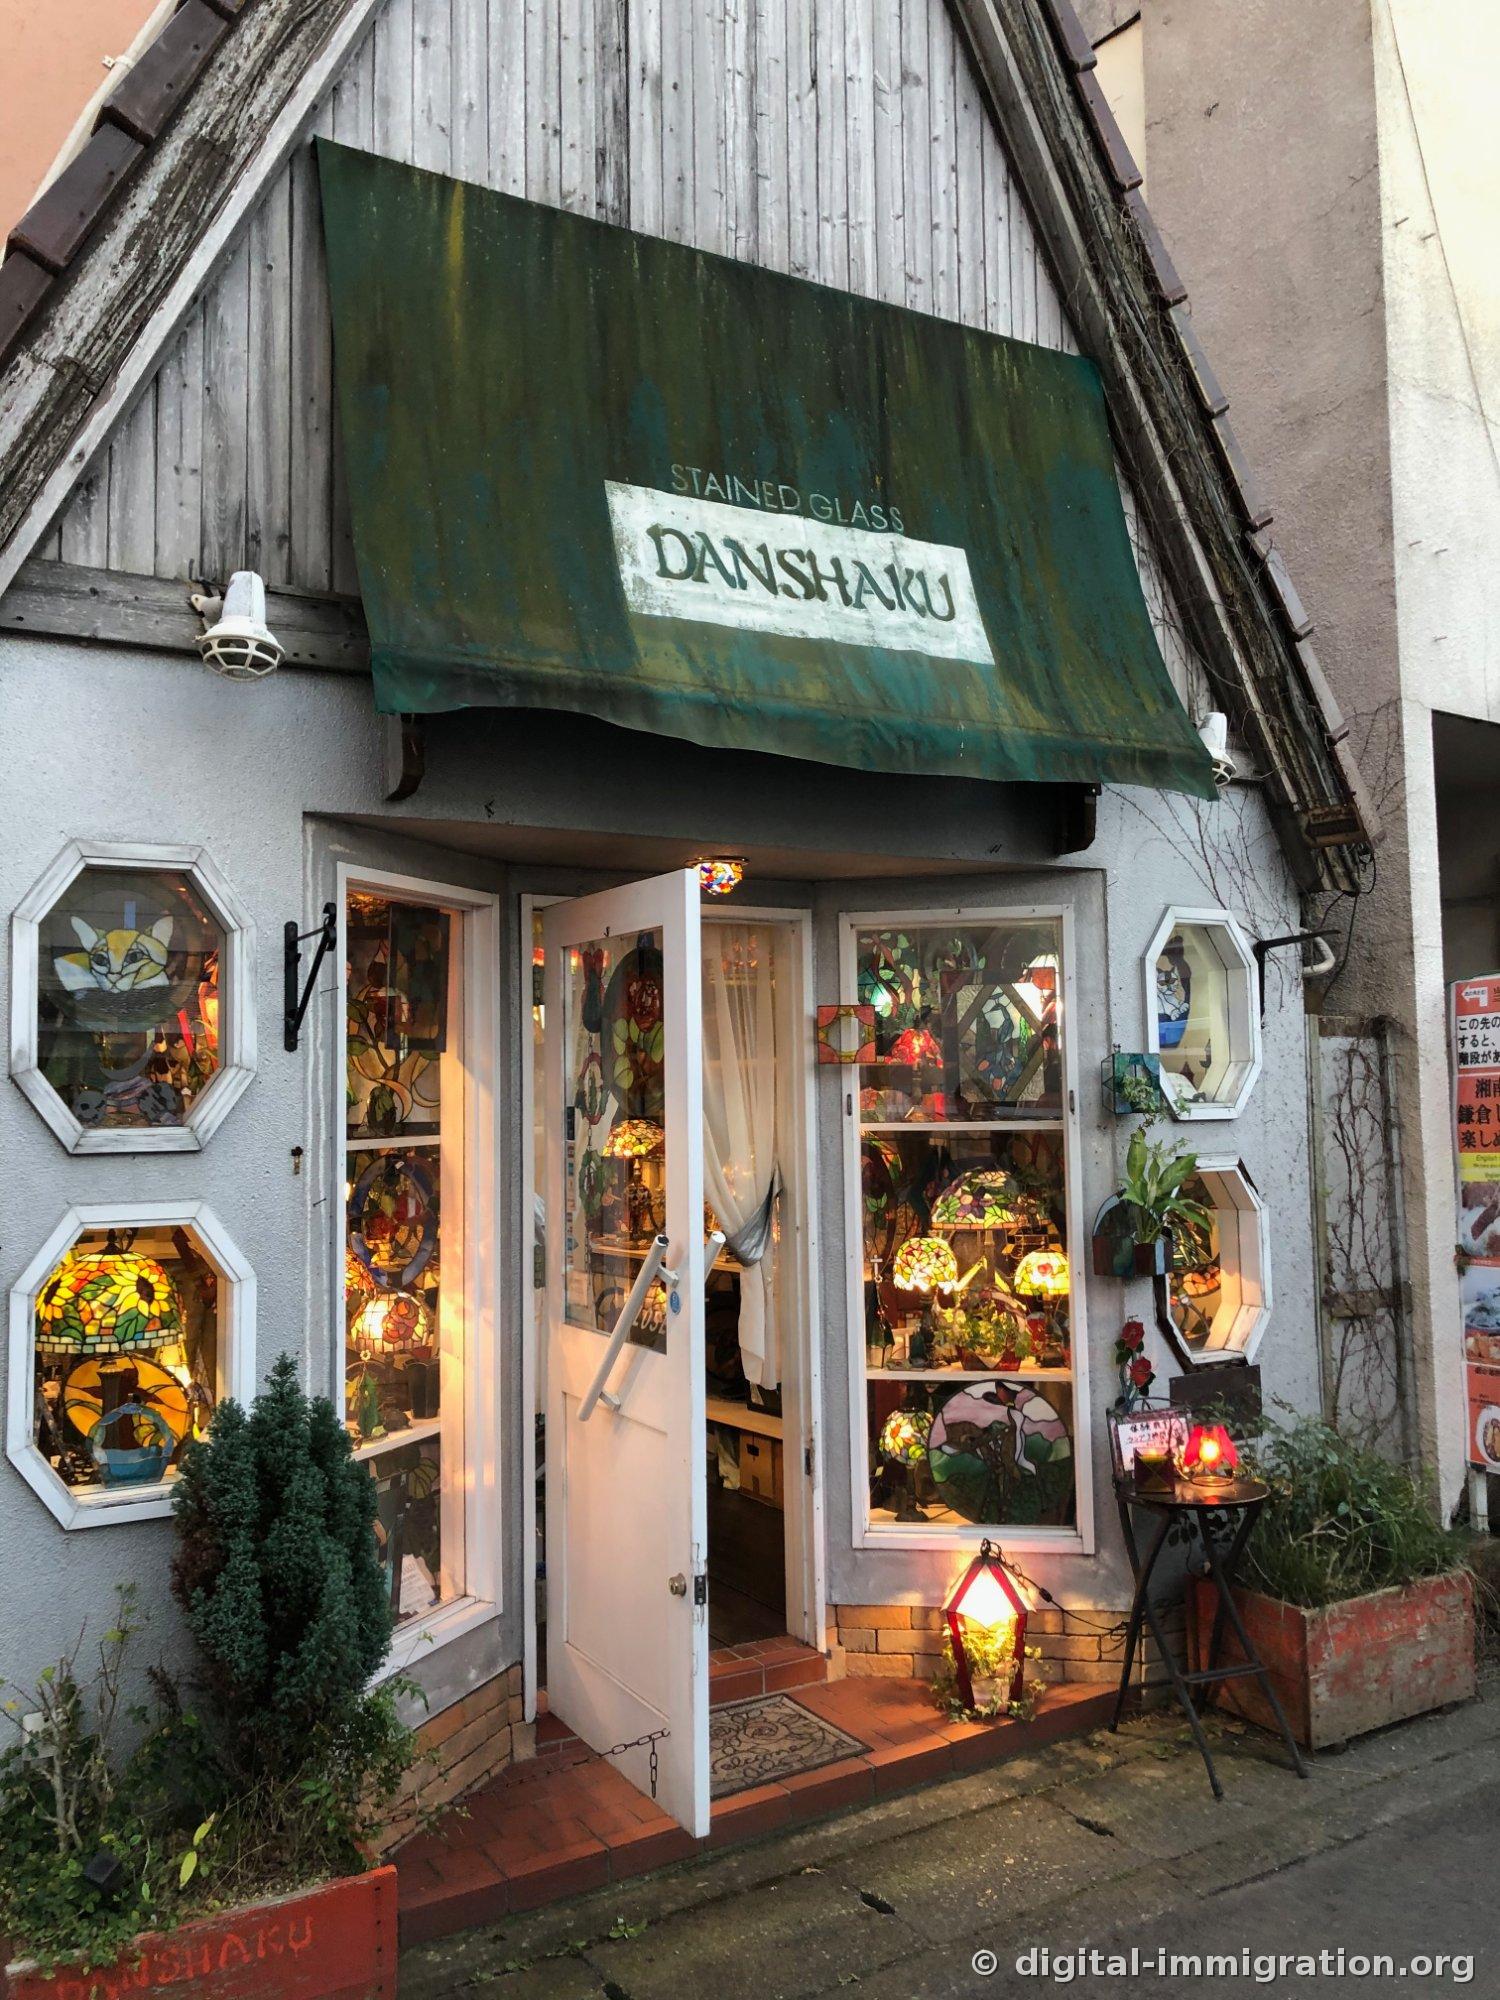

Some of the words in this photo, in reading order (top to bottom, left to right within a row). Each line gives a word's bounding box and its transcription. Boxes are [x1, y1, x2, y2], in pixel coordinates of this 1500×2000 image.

[671, 463, 800, 511] STAINED
[808, 493, 905, 532] GLASS
[645, 522, 956, 622] DANSHAKU
[1459, 1016, 1500, 1031] この先の
